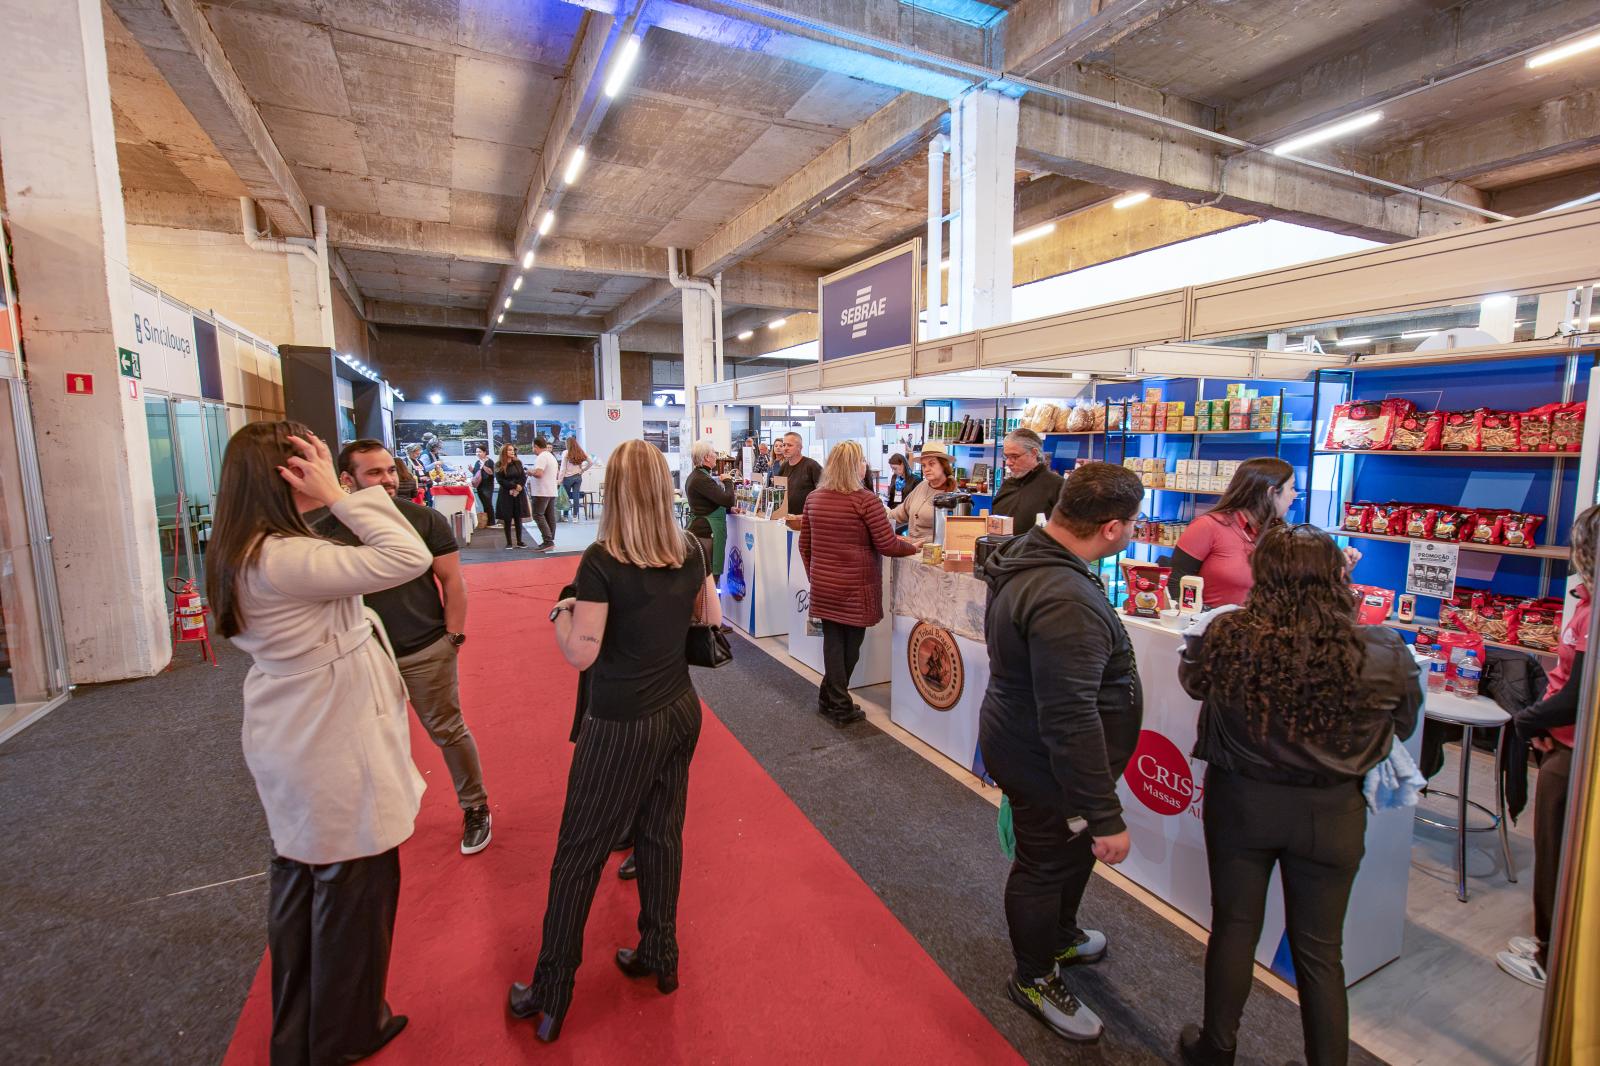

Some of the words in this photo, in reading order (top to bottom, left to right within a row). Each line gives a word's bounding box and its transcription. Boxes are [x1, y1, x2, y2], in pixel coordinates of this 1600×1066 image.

[840, 297, 887, 326] SEBRAE
[1417, 552, 1450, 561] PROMOÇÃO
[918, 627, 934, 638] Tribal
[935, 628, 952, 652] Brasil
[1137, 754, 1193, 797] CRIS
[1142, 781, 1181, 809] Massas
